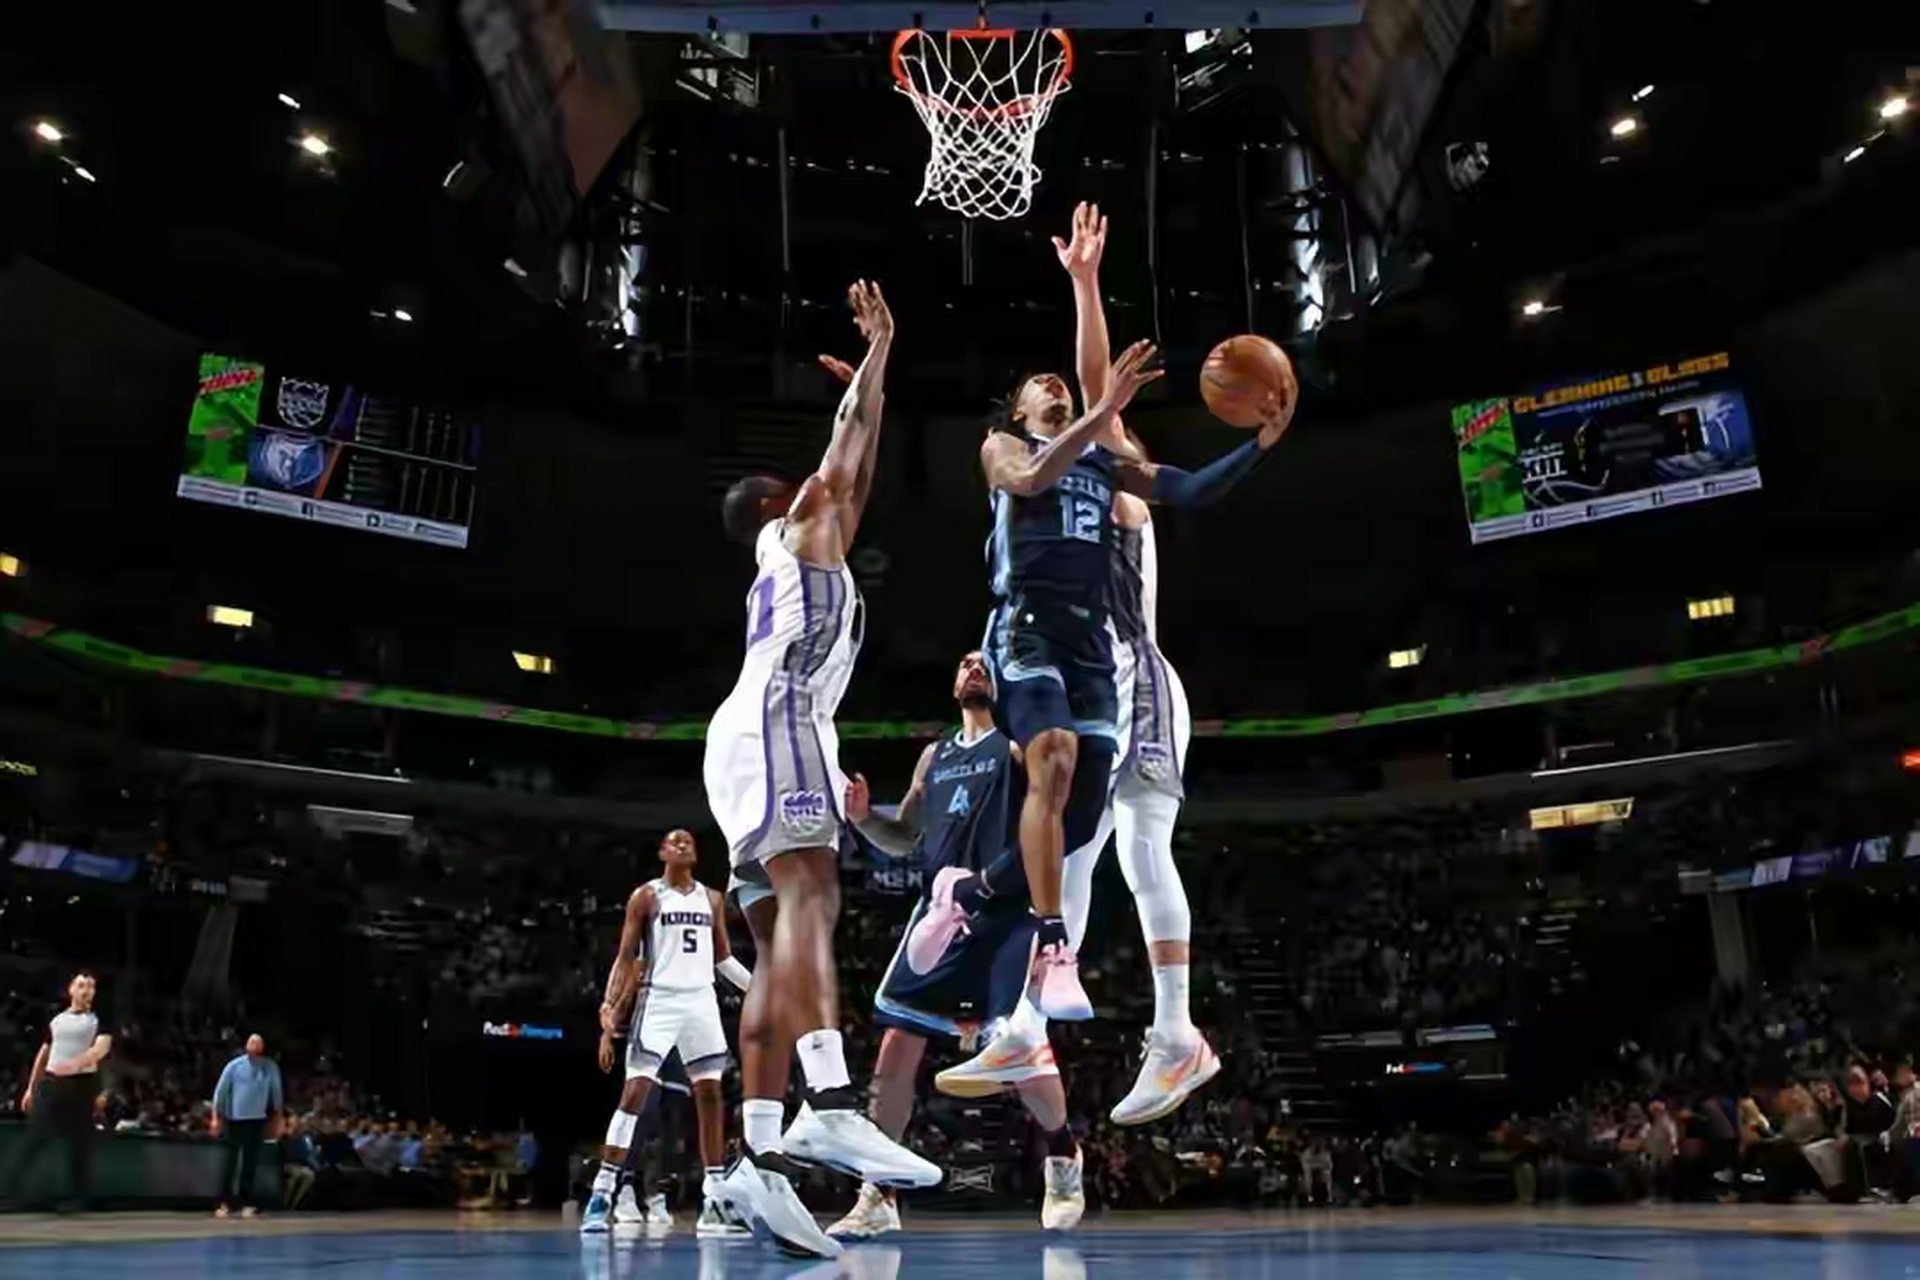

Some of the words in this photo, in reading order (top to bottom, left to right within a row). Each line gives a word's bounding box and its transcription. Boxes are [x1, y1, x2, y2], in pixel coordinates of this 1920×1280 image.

[1060, 496, 1101, 543] 12
[947, 783, 970, 816] 4
[682, 928, 698, 953] 5
